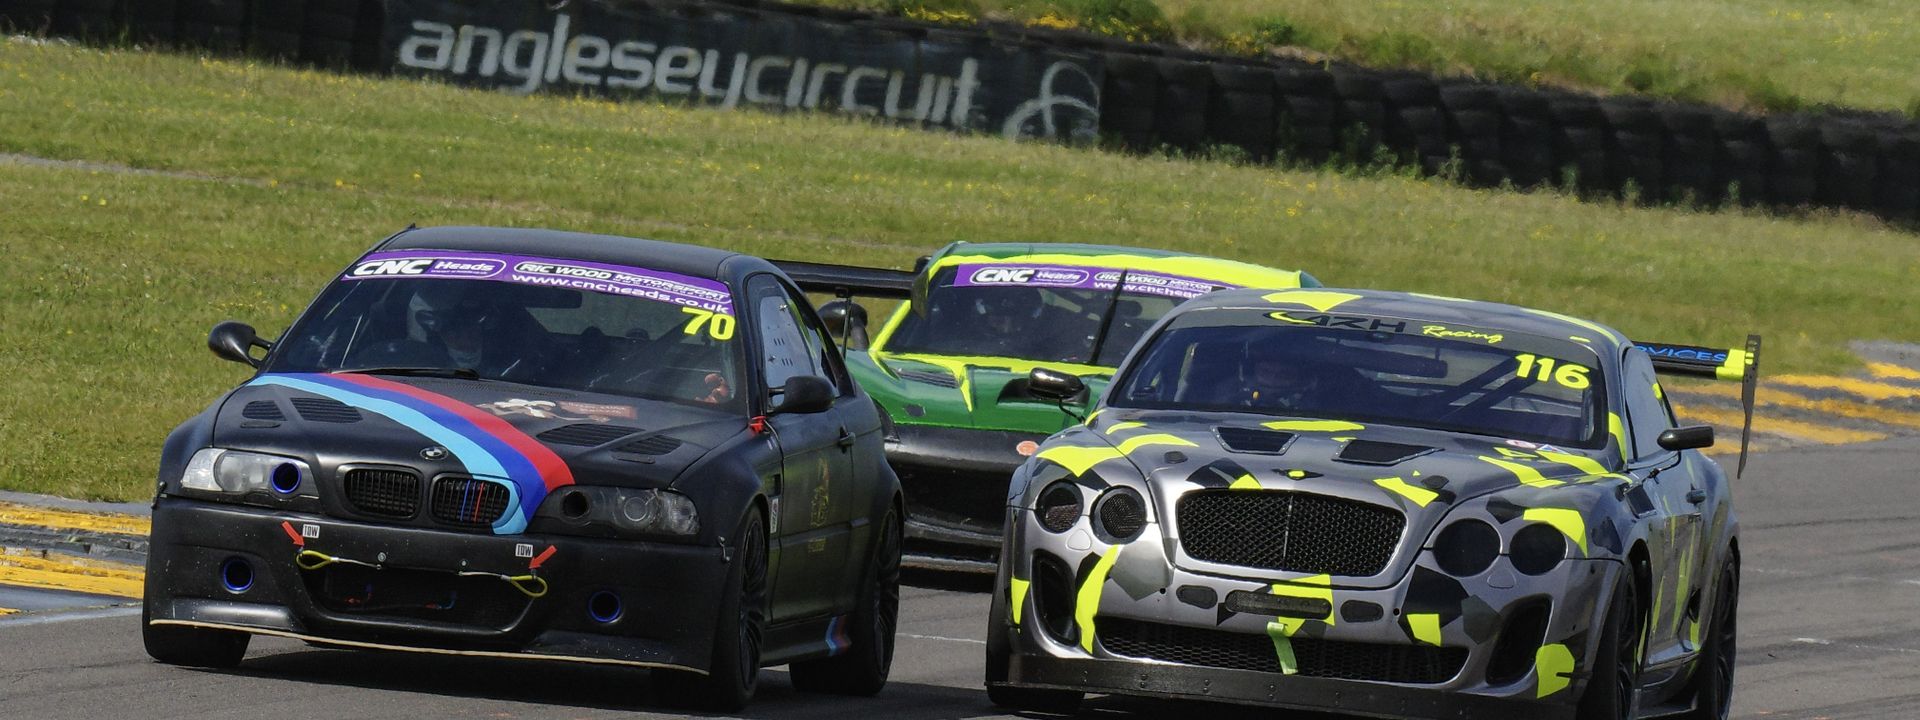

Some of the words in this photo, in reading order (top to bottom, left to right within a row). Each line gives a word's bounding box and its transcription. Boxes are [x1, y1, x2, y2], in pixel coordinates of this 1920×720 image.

[353, 259, 434, 276] CNC
[435, 261, 494, 272] Heads
[975, 269, 1035, 283] CNC
[518, 263, 554, 273] RIC
[555, 266, 612, 280] WOOD
[614, 273, 730, 299] MOTORSPORT
[1125, 274, 1168, 286] WOOD
[511, 273, 730, 314] www.cncheads.co.uk
[682, 306, 736, 341] 70
[1421, 325, 1504, 344] Racing
[1514, 353, 1590, 390] 116
[303, 525, 319, 538] TOW
[517, 544, 532, 557] TOW
